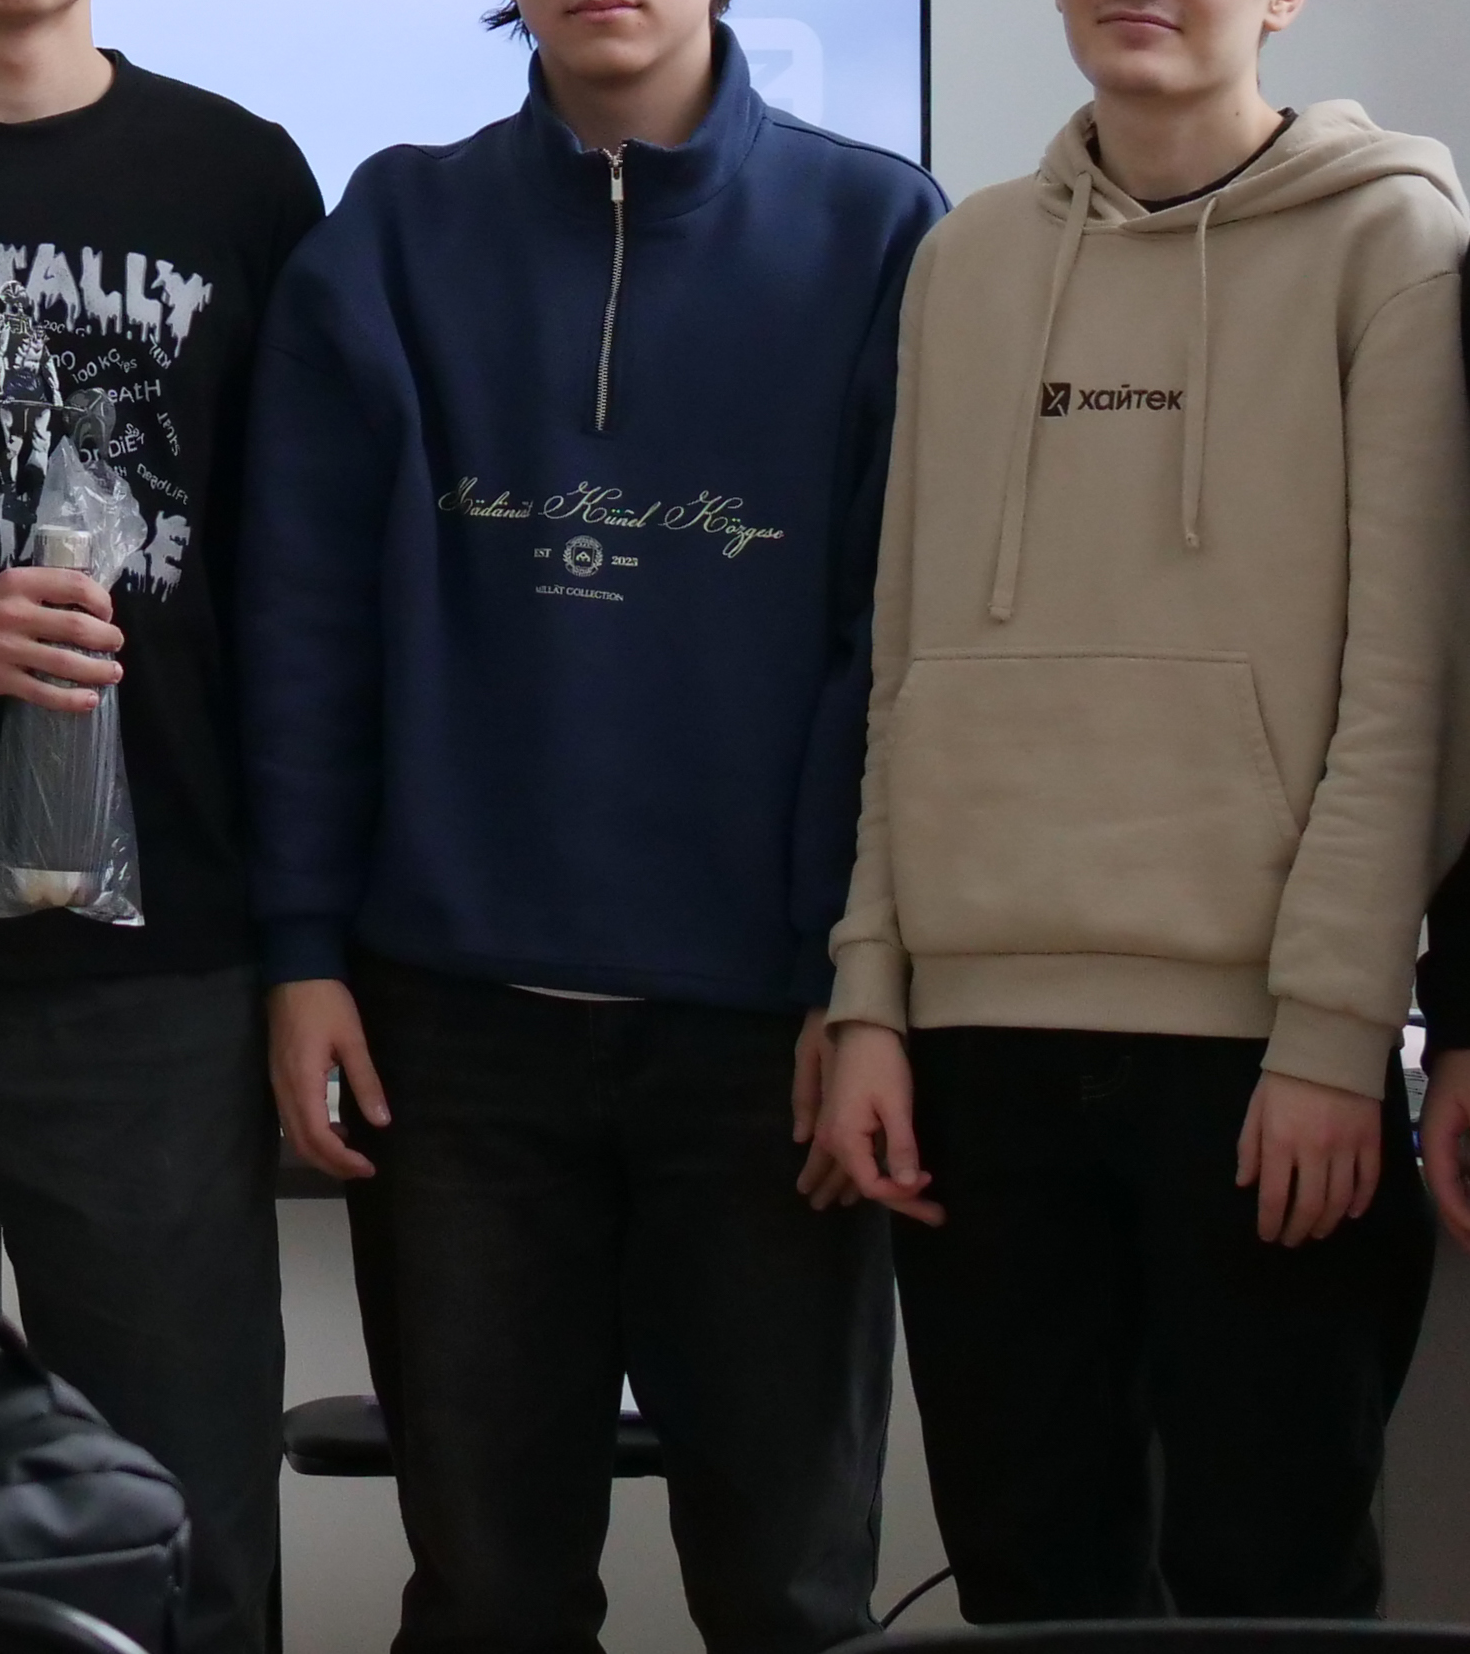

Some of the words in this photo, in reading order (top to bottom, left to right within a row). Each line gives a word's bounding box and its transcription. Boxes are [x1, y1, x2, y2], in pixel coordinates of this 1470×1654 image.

[1077, 384, 1183, 411] хайтек
[534, 547, 552, 558] EST
[565, 586, 624, 602] COLLECTION
